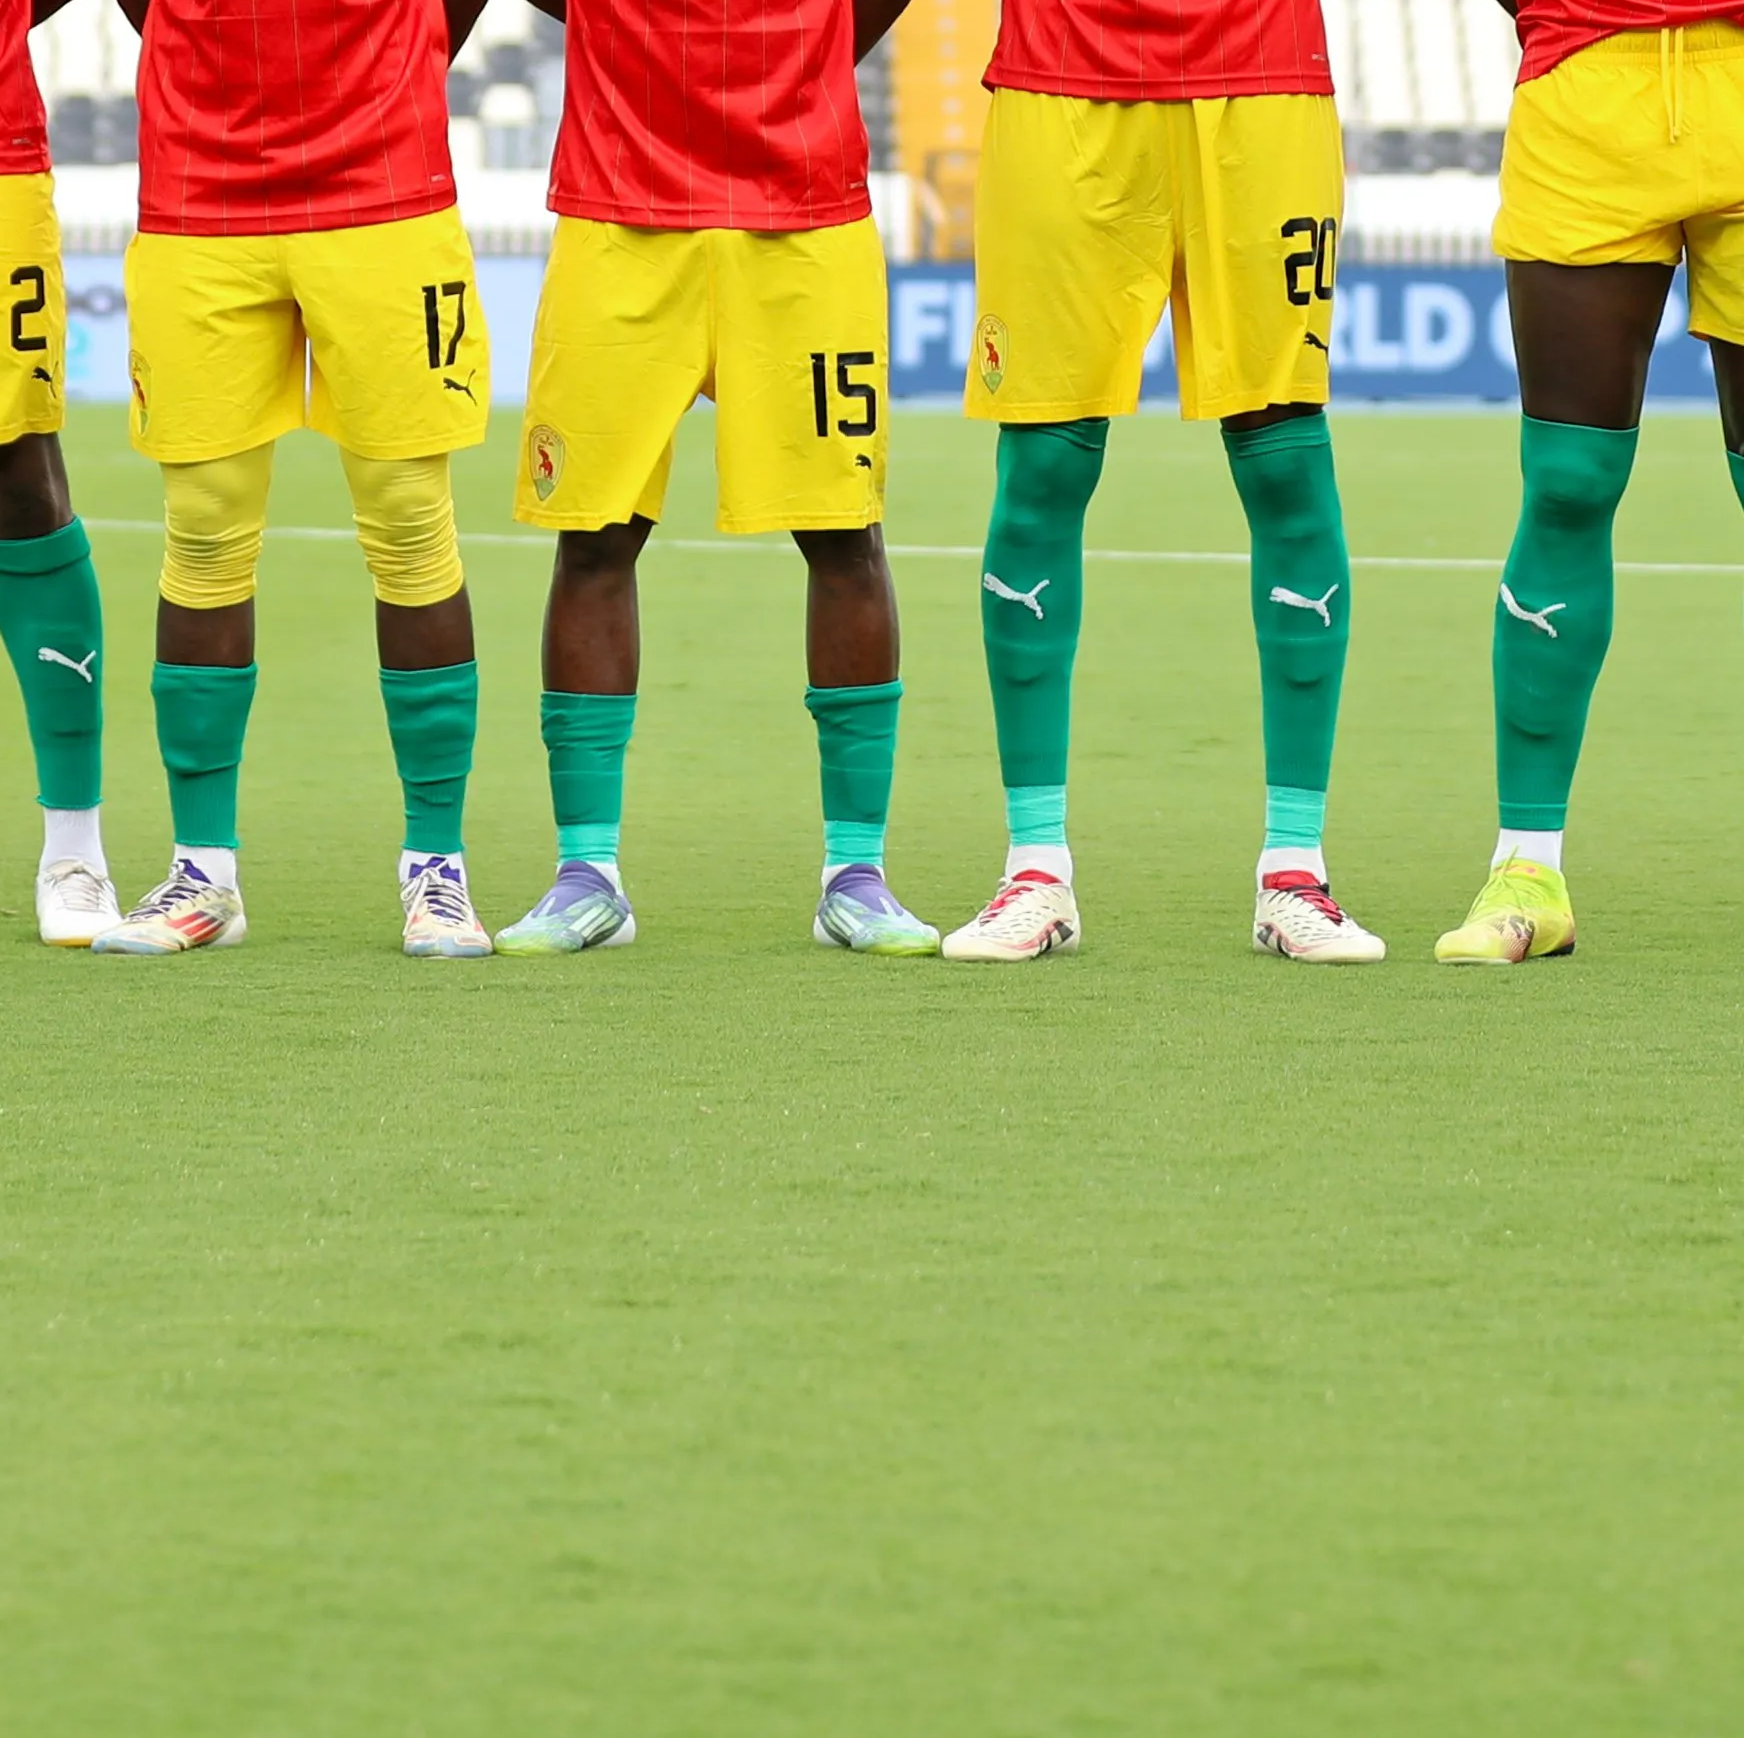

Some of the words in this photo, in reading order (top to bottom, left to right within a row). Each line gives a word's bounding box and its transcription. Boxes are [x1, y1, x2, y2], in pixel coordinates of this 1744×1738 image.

[1280, 217, 1335, 306] 20
[10, 265, 47, 352] 2
[422, 281, 466, 369] 17
[810, 351, 877, 438] 15
